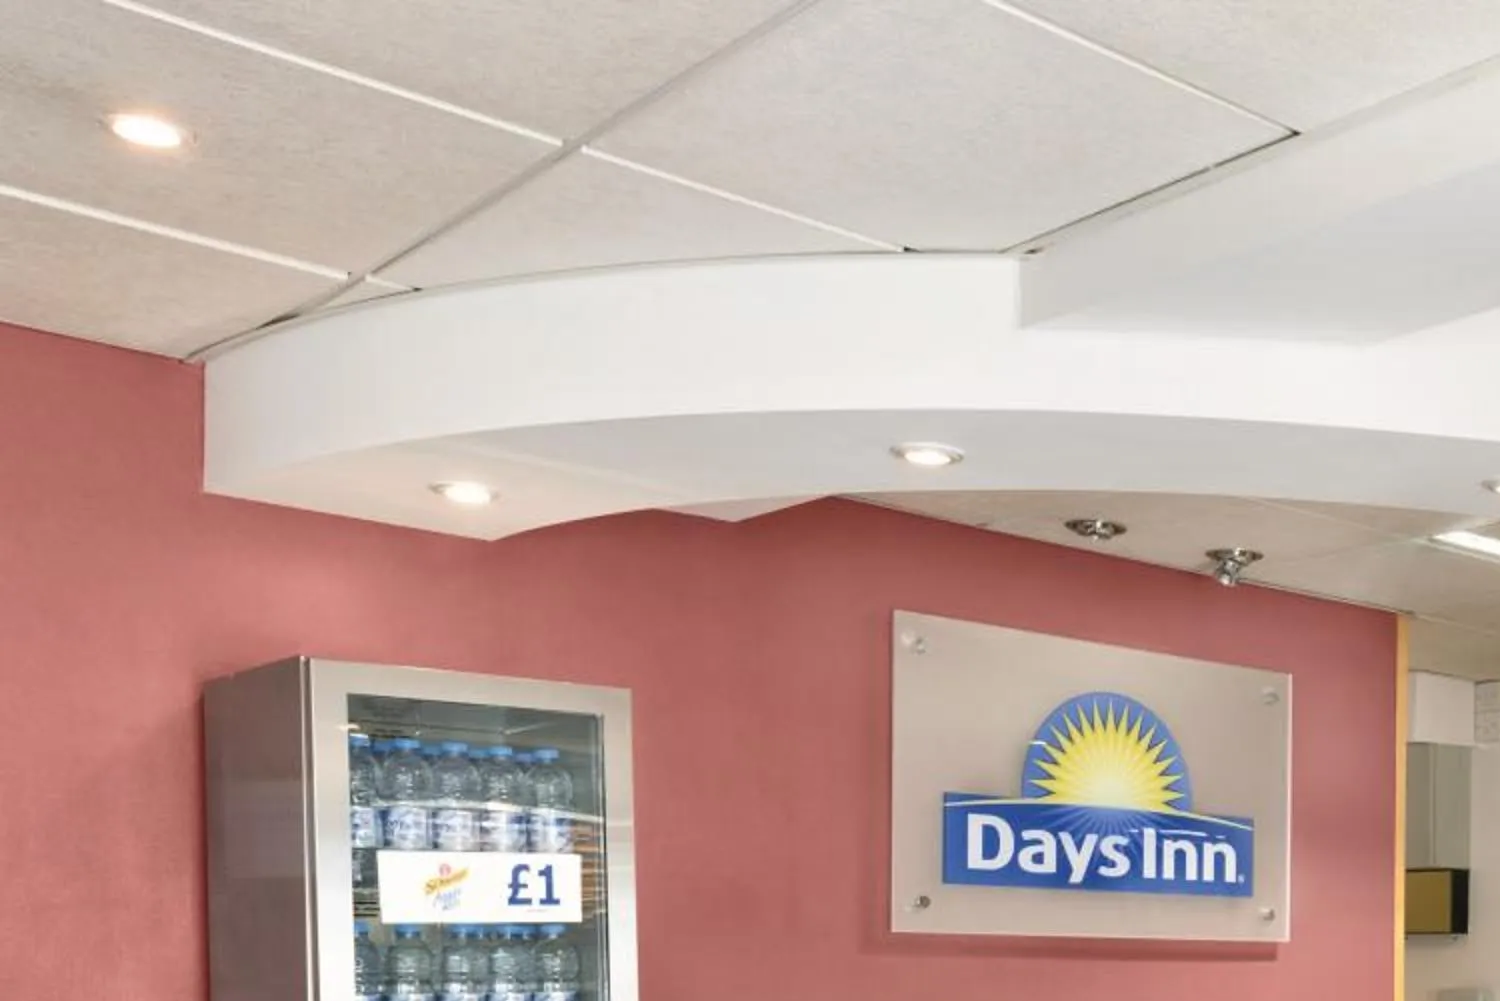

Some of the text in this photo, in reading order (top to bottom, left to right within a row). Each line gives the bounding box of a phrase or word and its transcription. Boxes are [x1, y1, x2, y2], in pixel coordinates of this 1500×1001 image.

[967, 813, 1238, 884] Days Inn
[507, 863, 561, 906] £1
